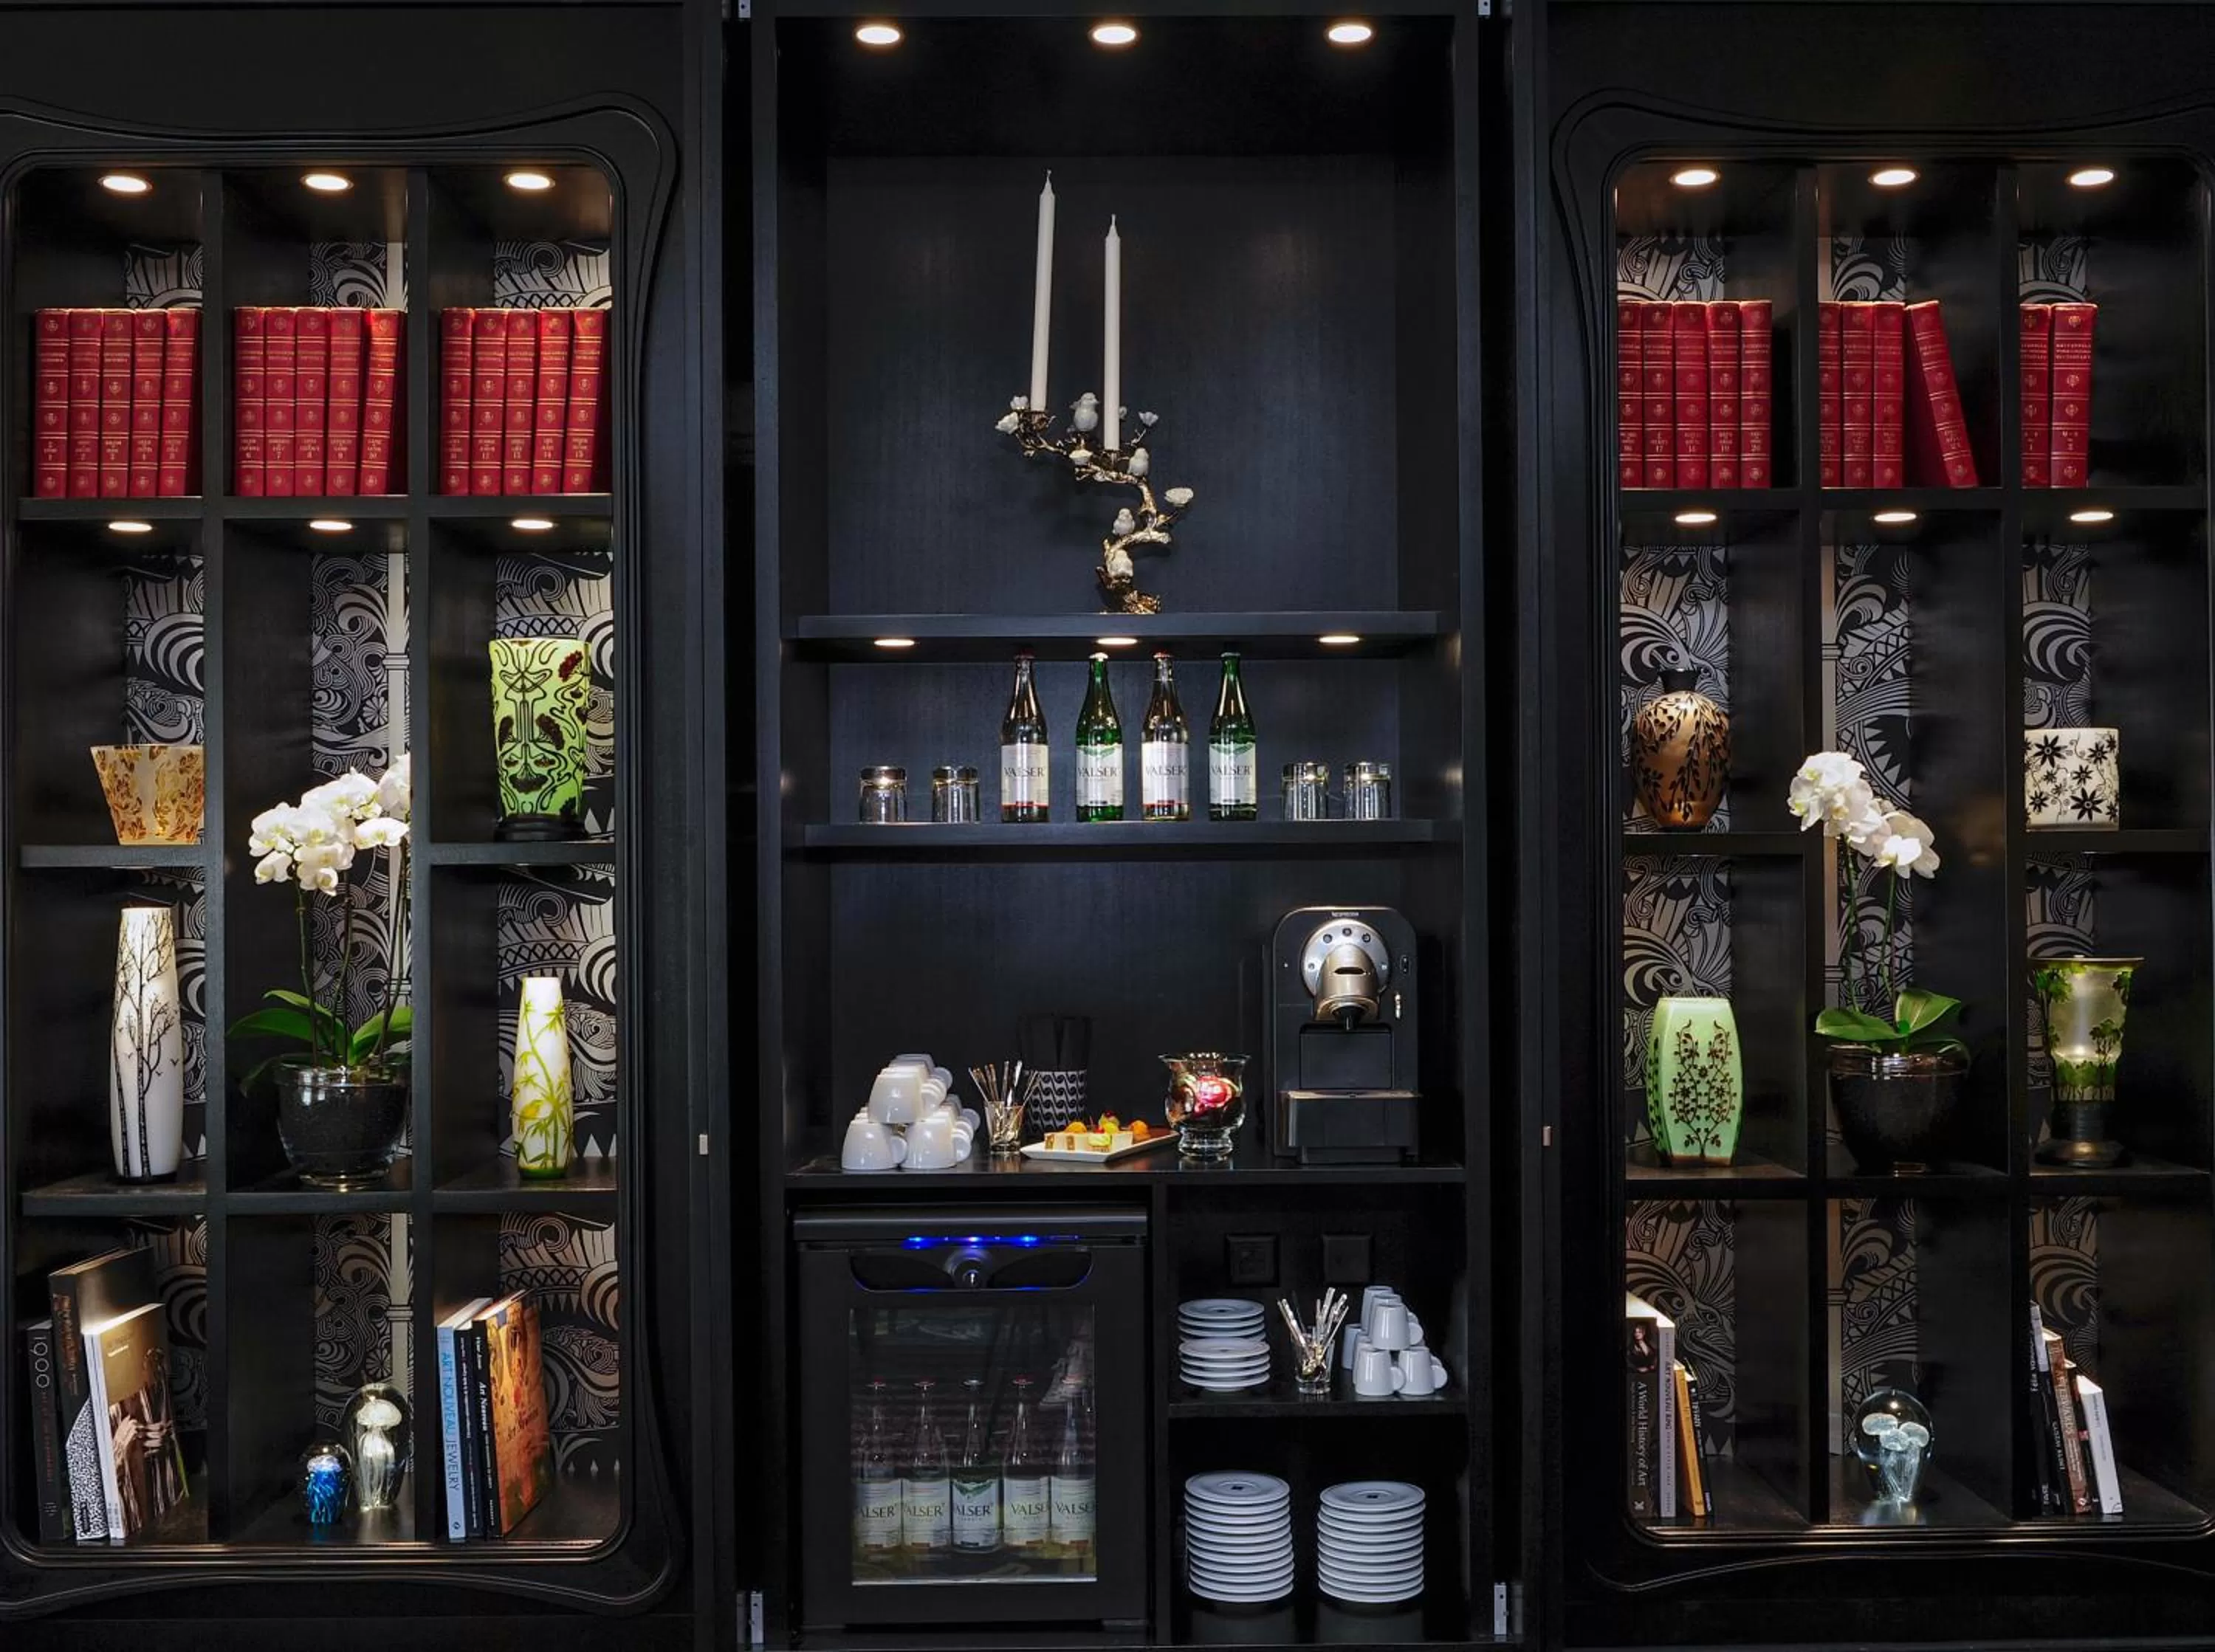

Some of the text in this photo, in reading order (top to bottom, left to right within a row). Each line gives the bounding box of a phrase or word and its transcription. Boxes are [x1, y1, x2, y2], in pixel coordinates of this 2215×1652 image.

[1077, 767, 1118, 777] VALSER
[1146, 766, 1187, 776] VALSER
[1211, 765, 1251, 775] VALSER
[32, 1336, 50, 1388] 1900
[440, 1352, 461, 1490] ART NOUVEAU JEWELRY
[860, 1505, 896, 1518] ALSER
[956, 1504, 991, 1517] ALSER
[1011, 1502, 1048, 1515] VALSE
[1055, 1501, 1093, 1513] VALSE
